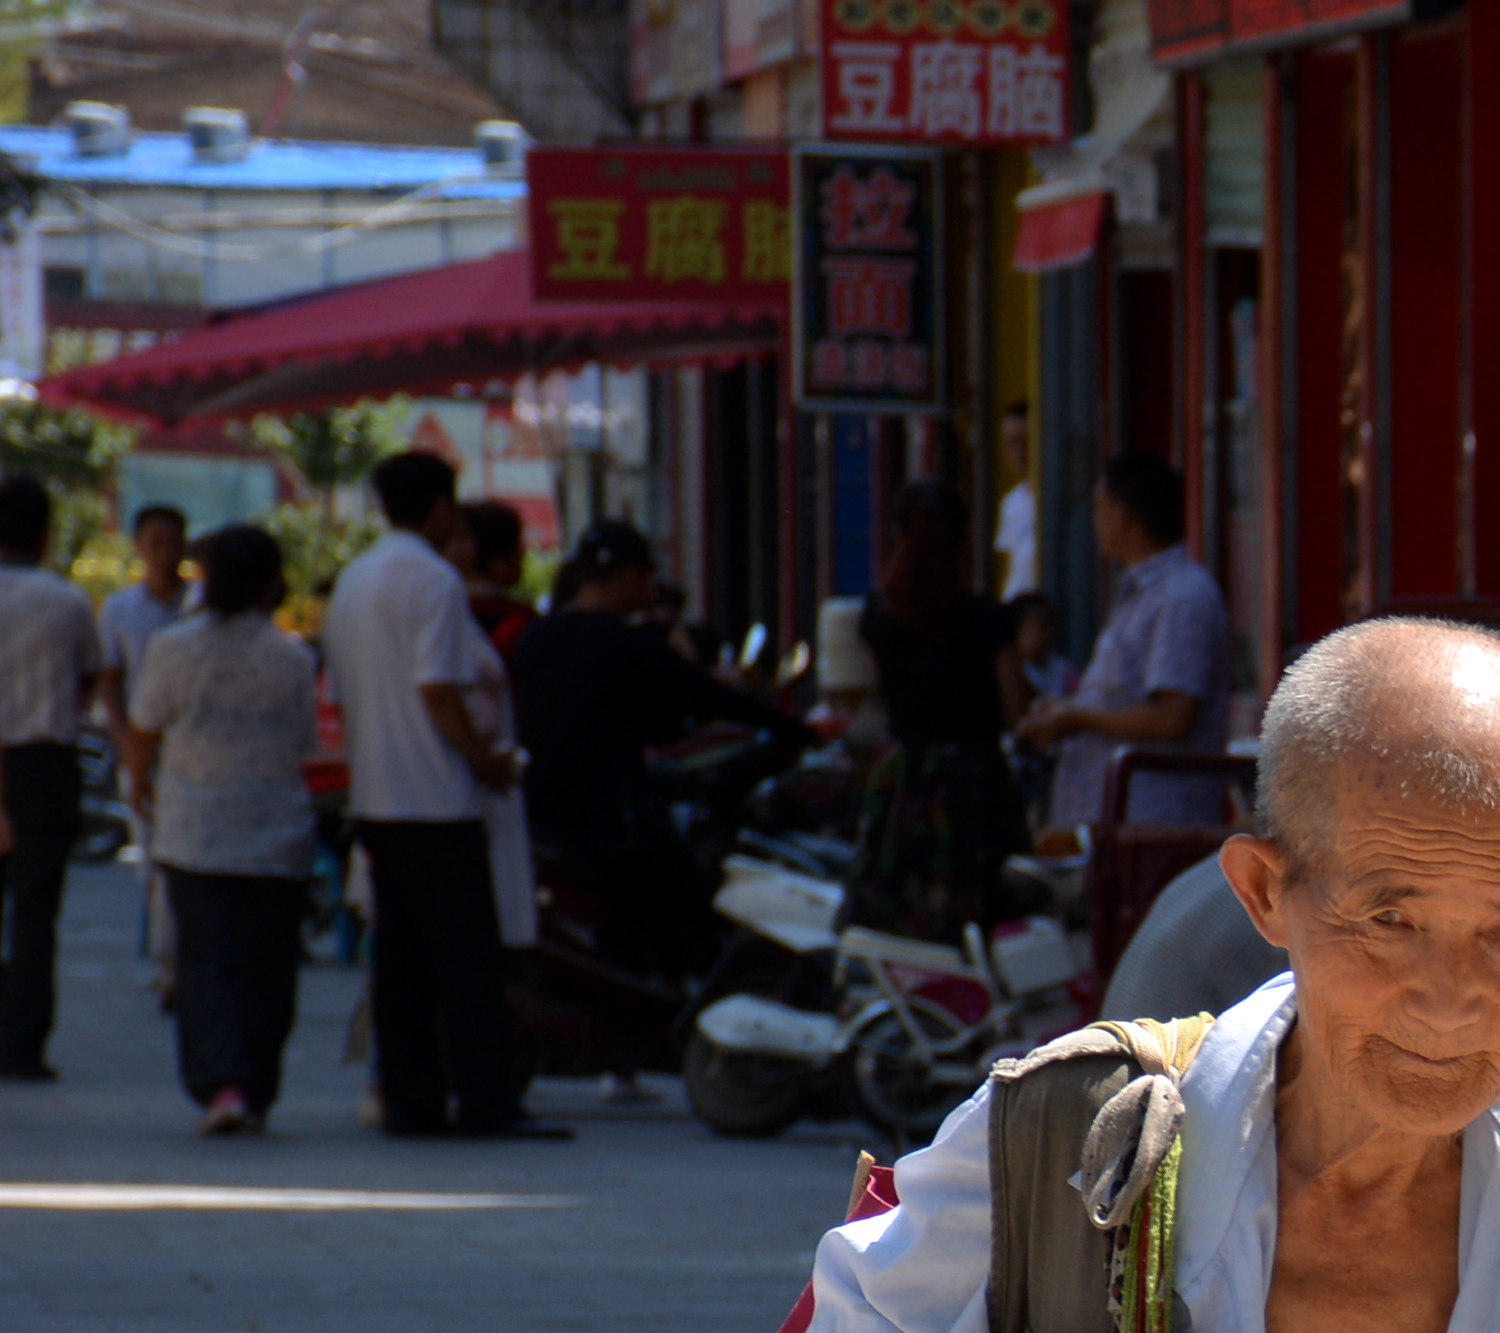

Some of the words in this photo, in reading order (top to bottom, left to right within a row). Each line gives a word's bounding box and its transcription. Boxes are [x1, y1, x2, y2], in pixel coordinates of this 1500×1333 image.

[829, 38, 1066, 140] 豆腐脑
[820, 163, 920, 337] 拉面
